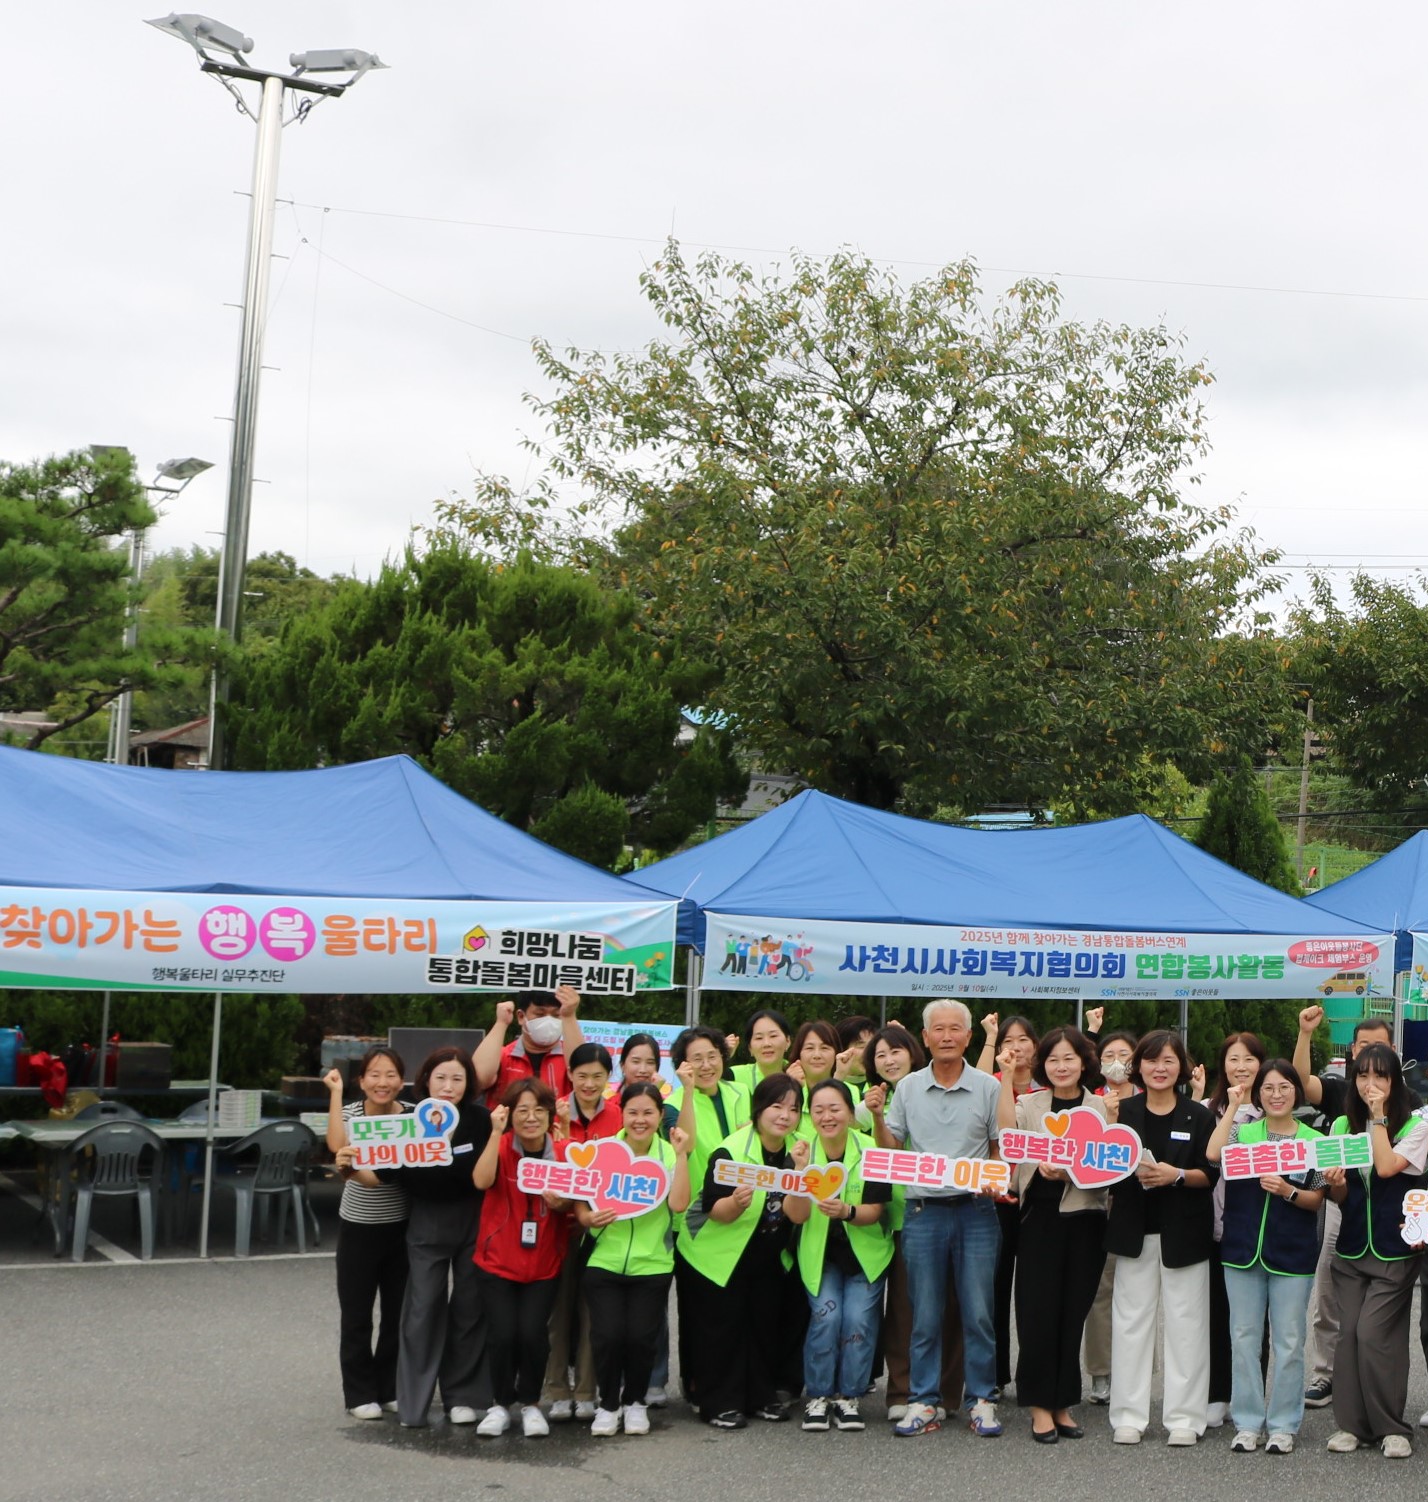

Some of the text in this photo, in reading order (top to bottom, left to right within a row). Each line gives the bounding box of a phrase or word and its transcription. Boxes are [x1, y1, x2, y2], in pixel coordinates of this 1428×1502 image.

[0, 903, 437, 957] 찾아가는 행복 울타리
[500, 930, 602, 960] 희망나눔
[960, 930, 1187, 948] 2025년 함께 찾아가는 경남통합돌봄버스연계
[152, 967, 286, 983] 행복울타리 실무추진단
[427, 957, 635, 993] 통합돌봄마을센터
[838, 944, 1285, 980] 사천시사회복지협의회 연합봉사활동
[1100, 988, 1117, 997] SSN
[1174, 989, 1190, 997] SSN
[353, 1116, 417, 1141] 모두가
[355, 1141, 449, 1166] 나의 이웃
[1002, 1131, 1131, 1173] 행복한 사천
[1224, 1136, 1372, 1177] 촘촘한 돌봄
[520, 1161, 659, 1204] 행복한 사천
[718, 1163, 820, 1195] 든든한 이웃
[863, 1150, 1007, 1193] 든든한 이웃
